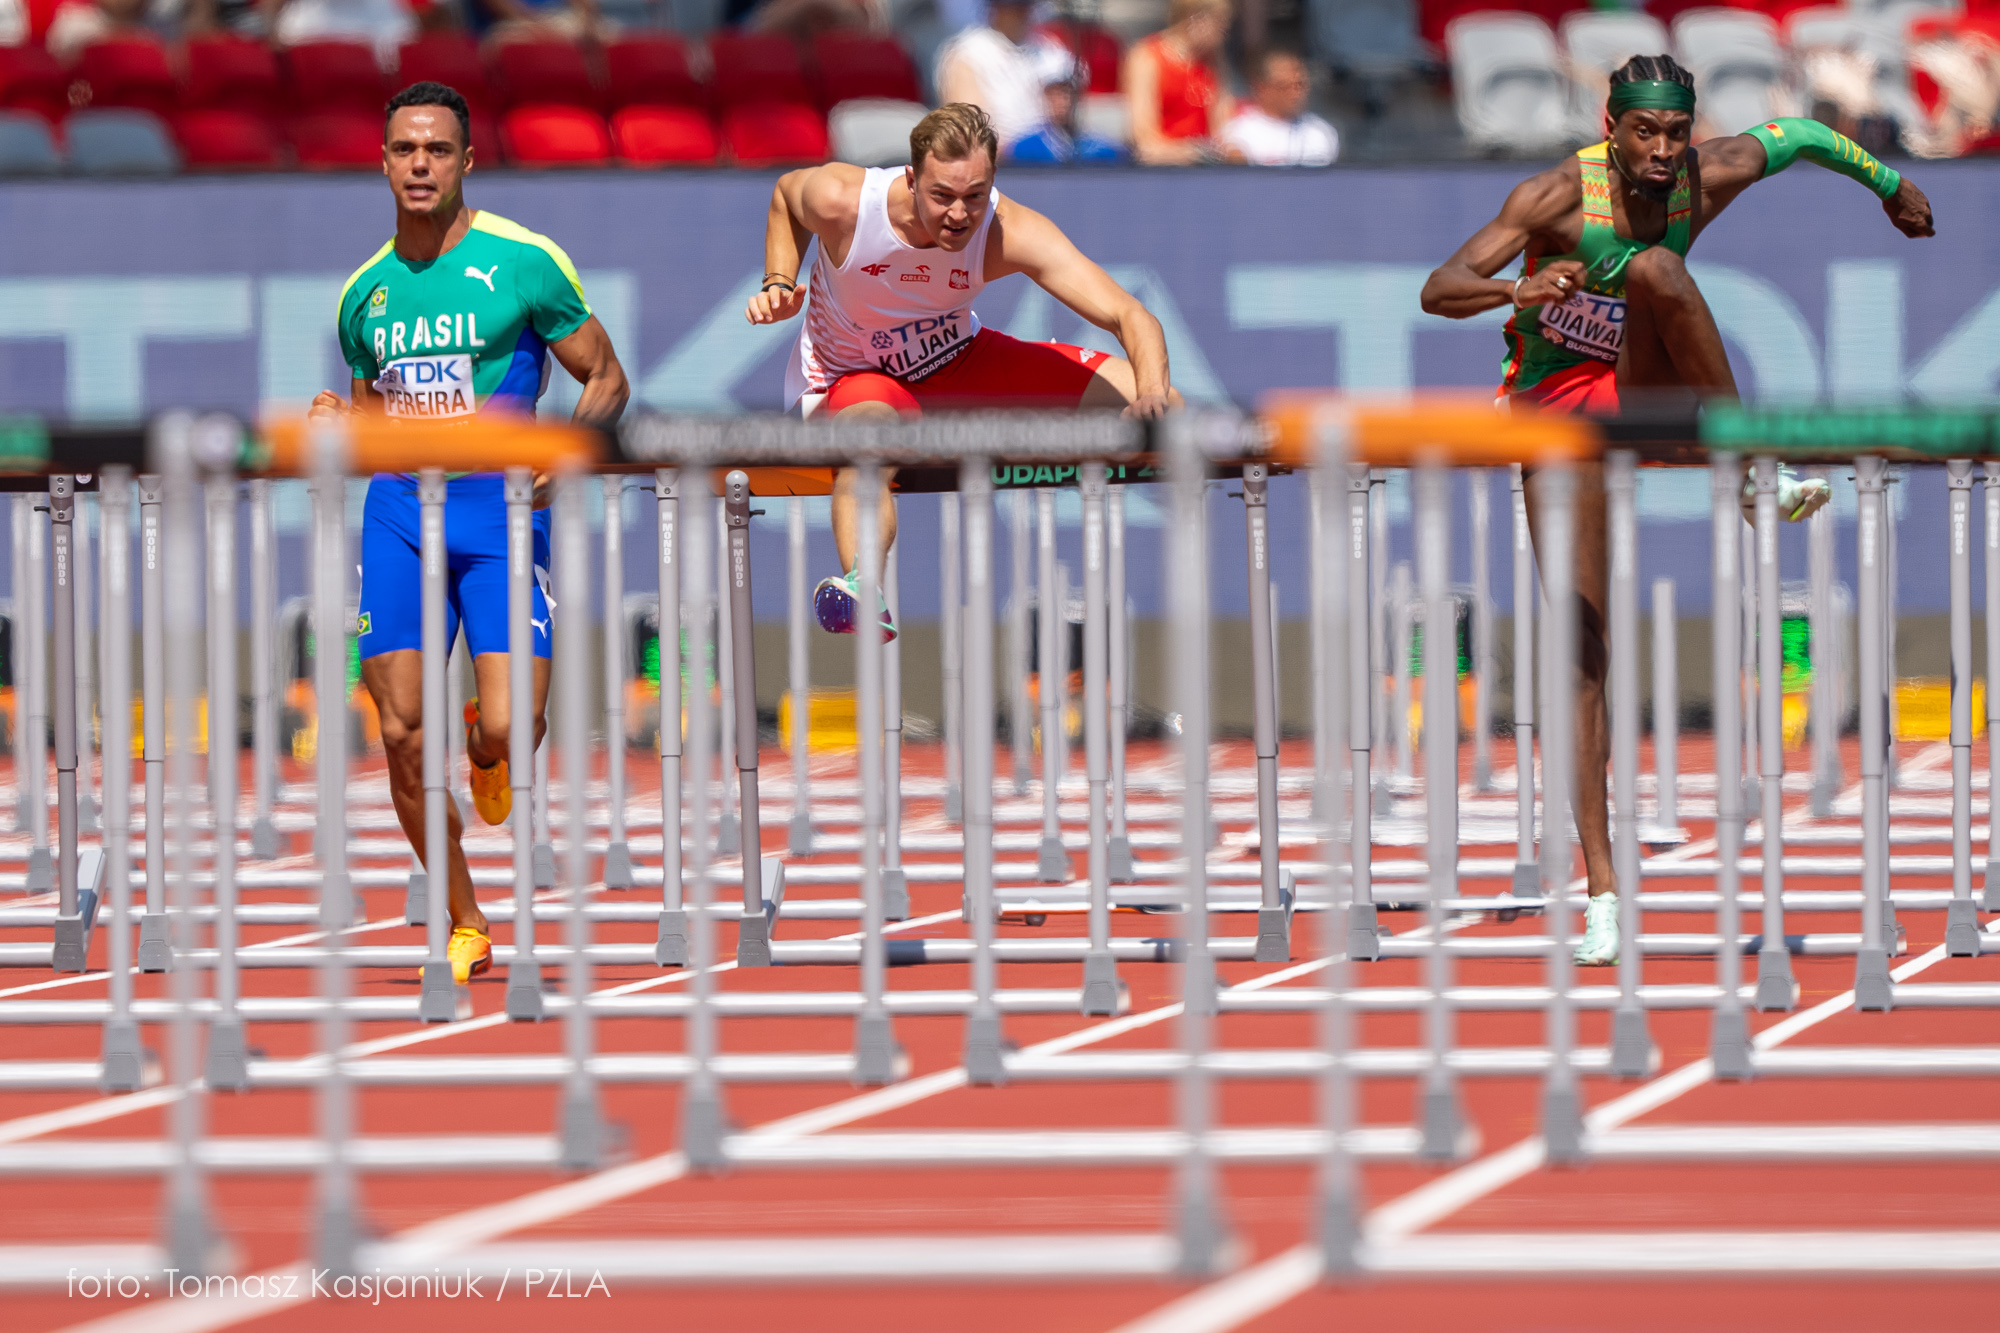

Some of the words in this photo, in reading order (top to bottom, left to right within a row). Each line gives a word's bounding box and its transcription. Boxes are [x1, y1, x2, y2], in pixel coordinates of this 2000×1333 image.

[1831, 130, 1878, 179] MALI
[861, 263, 891, 277] 4F
[890, 309, 964, 344] TDK
[1586, 298, 1627, 323] TD
[374, 312, 486, 360] BRASIL
[878, 323, 959, 374] KILJAN
[1564, 340, 1617, 362] BUDAPES
[393, 359, 462, 385] TDK
[907, 349, 958, 382] BUDAPEST
[386, 388, 468, 416] PEREIRA
[146, 529, 156, 568] MONDO
[662, 523, 673, 563] MONDO
[1253, 530, 1264, 569] MONDO
[1352, 518, 1363, 558] MONDO
[1954, 513, 1965, 554] MONDO
[57, 547, 66, 585] MONDO
[733, 549, 744, 587] MONDO
